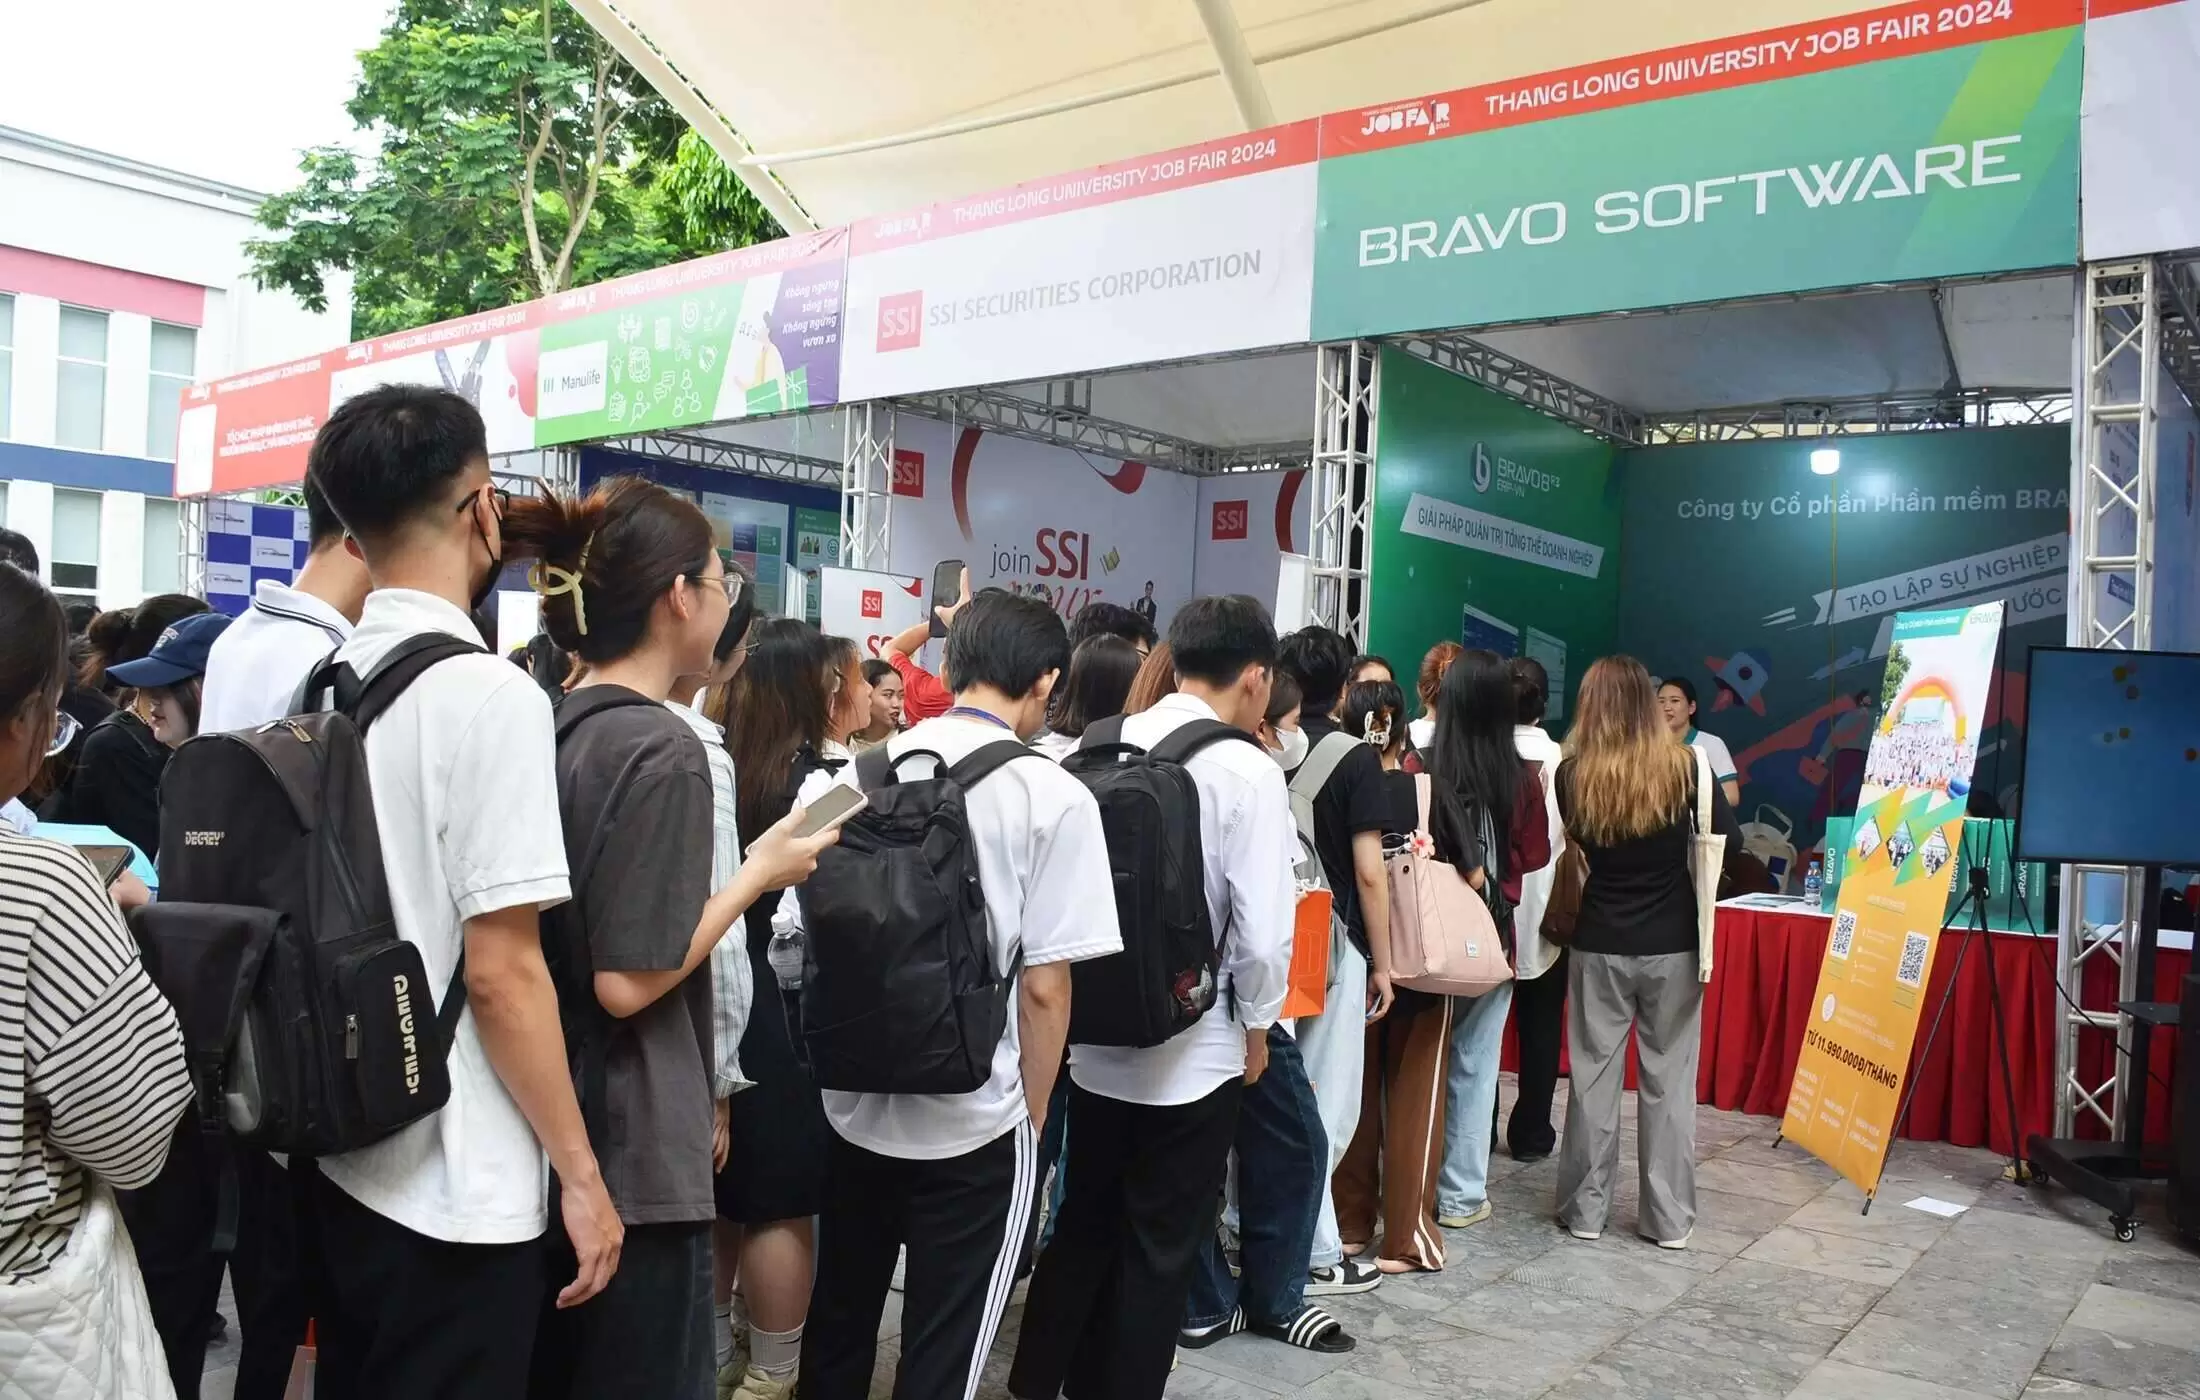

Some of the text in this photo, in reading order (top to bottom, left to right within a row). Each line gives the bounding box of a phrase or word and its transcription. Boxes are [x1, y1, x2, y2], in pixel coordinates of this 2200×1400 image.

[1484, 0, 2013, 116] THANG LONG UNIVERSITY JOB FAIR 2024
[953, 138, 1277, 224] THANG LONG UNIVERSITY JOB FAIR 2024
[1358, 134, 2024, 268] BRAVO SOFTWARE
[929, 249, 1261, 327] SSI SECURITIES CORPORATION
[882, 305, 918, 339] SSI
[562, 369, 601, 391] Manulife
[1216, 509, 1244, 531] SSI
[1439, 512, 1464, 534] PHÁP
[1677, 486, 2070, 521] Công ty Cổ phần Phần mềm BRA
[990, 527, 1090, 580] join SSI
[1846, 544, 2060, 613] TẠO LẬP SỰ NGHIỆP
[863, 596, 881, 612] SSI
[1825, 847, 1836, 884] BRAVO
[1817, 1035, 1898, 1089] 11.990.000Đ/THÁNG
